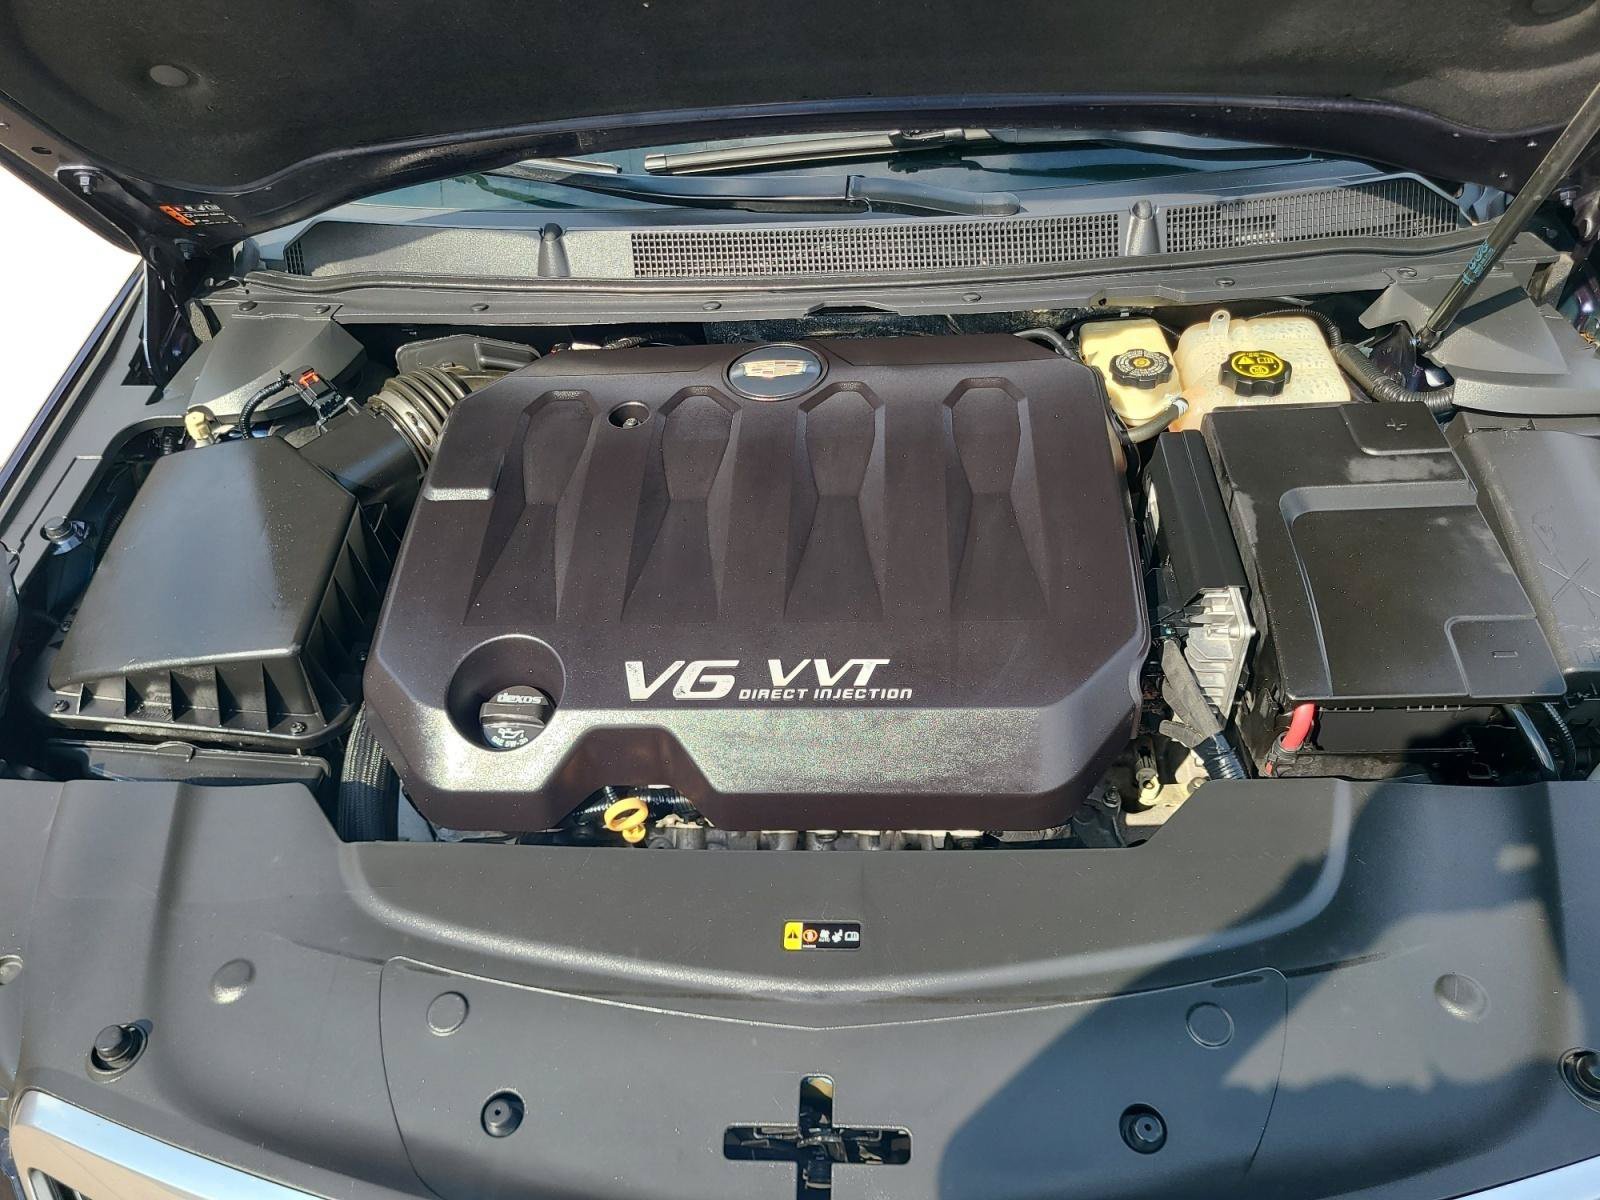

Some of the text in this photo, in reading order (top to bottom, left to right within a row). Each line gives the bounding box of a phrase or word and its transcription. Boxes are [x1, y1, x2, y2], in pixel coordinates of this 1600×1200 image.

[625, 659, 890, 701] V6 VVT
[496, 692, 544, 704] dexos
[738, 688, 913, 700] DIRECT INJECTION
